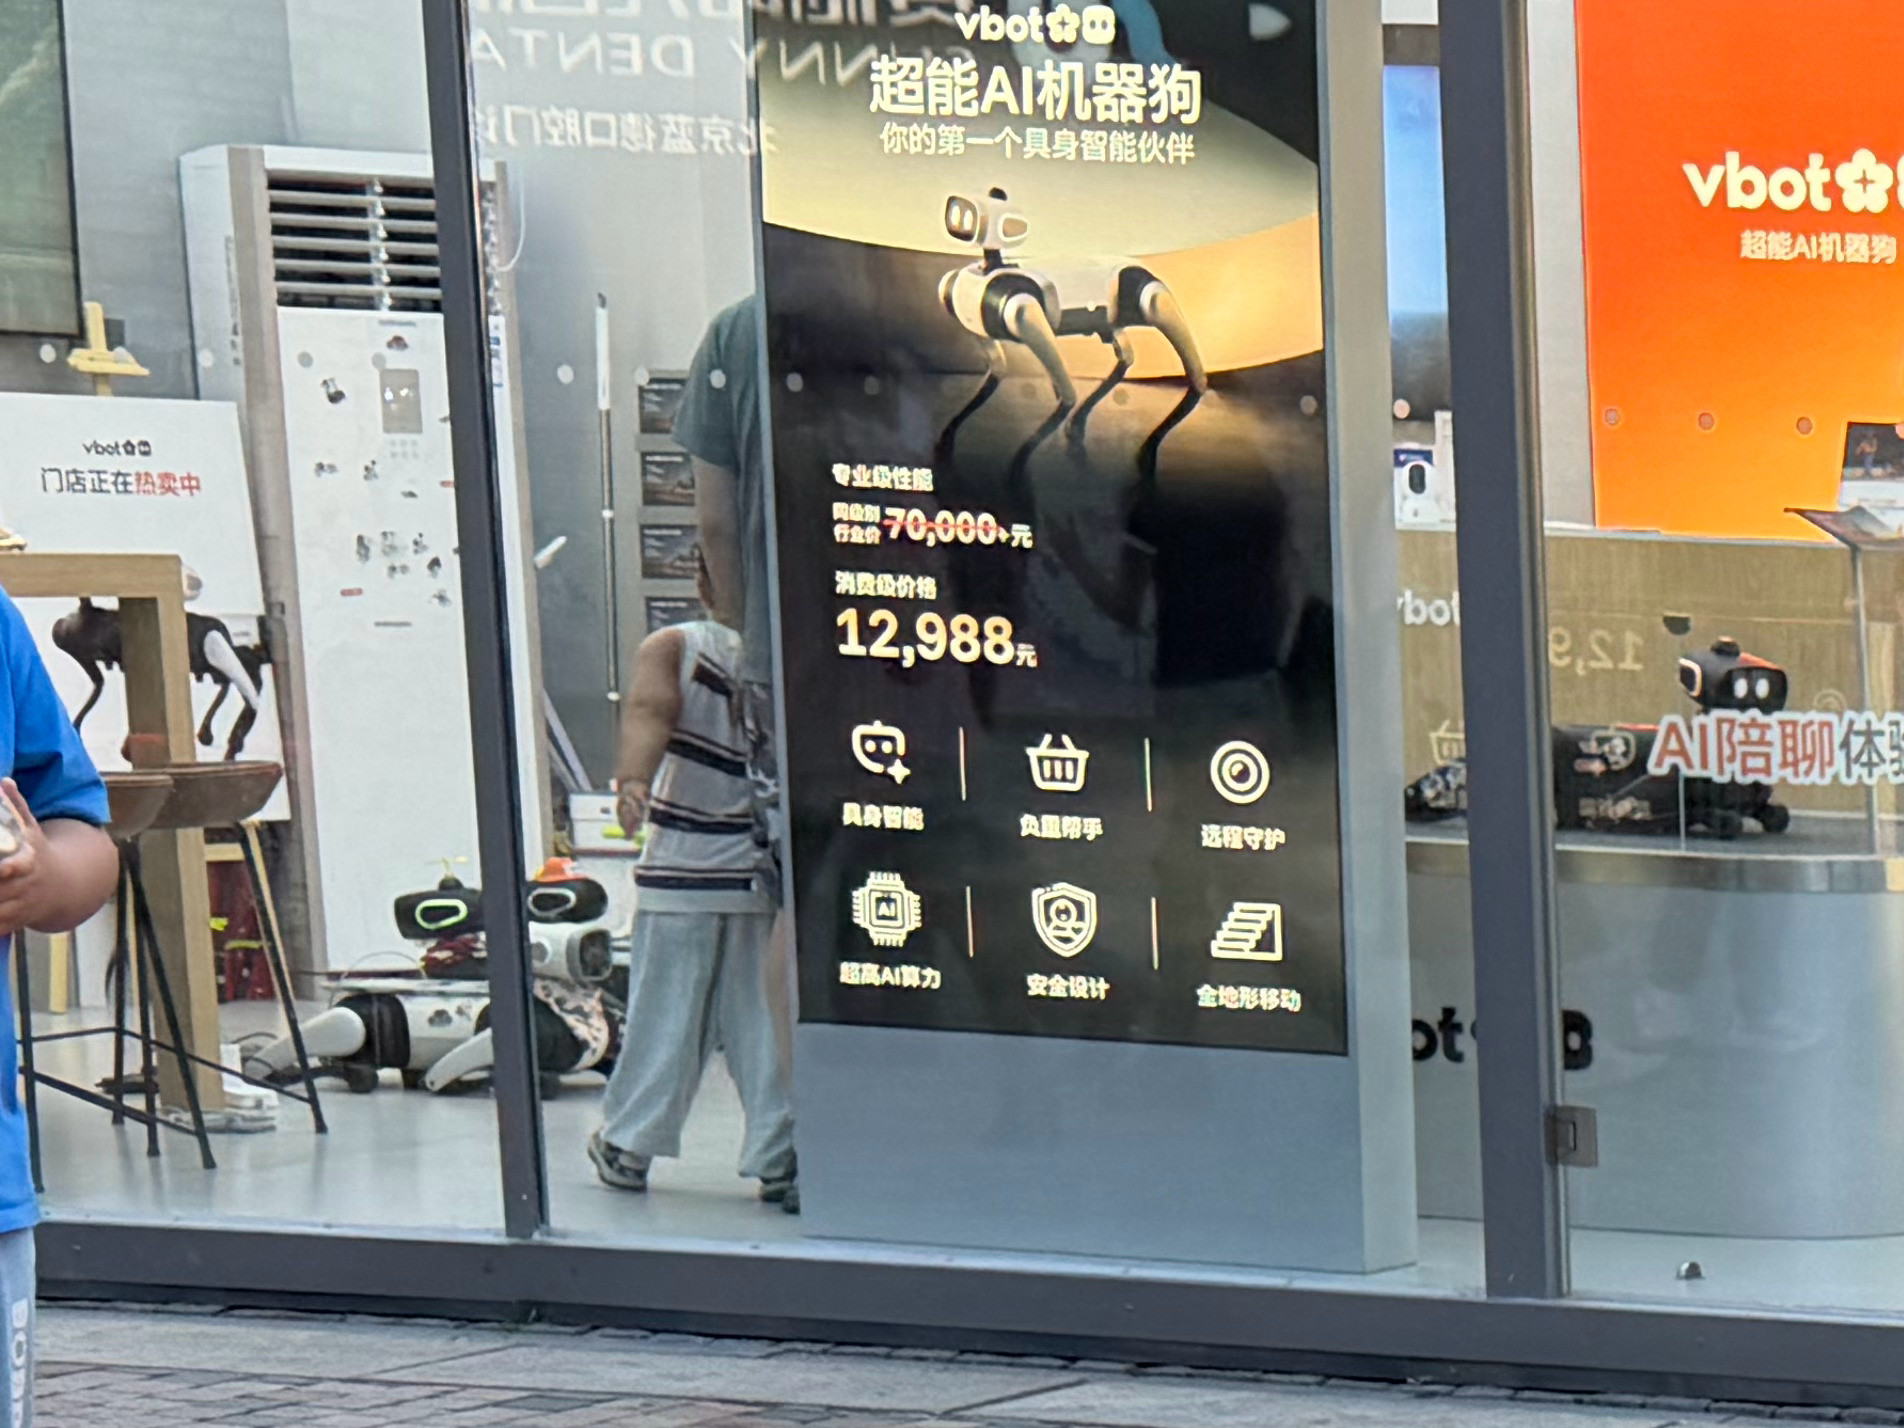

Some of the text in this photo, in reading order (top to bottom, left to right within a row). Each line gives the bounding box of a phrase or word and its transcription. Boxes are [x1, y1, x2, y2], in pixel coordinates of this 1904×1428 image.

[955, 5, 1044, 42] vbot
[870, 54, 1201, 124] 超能AI机器狗
[880, 121, 1195, 165] 你的第一个具身智能伙伴
[1682, 151, 1832, 212] vbot
[1740, 229, 1896, 264] 超能AI机器狗
[41, 467, 202, 496] 门店正在热卖中
[835, 570, 937, 600] 消费级价格
[842, 802, 925, 831] 具身智能
[1201, 824, 1286, 851] 远程守护
[839, 961, 942, 990] 超高AI算力
[1026, 973, 1111, 1000] 安全设计
[1196, 983, 1302, 1012] 全地形移动
